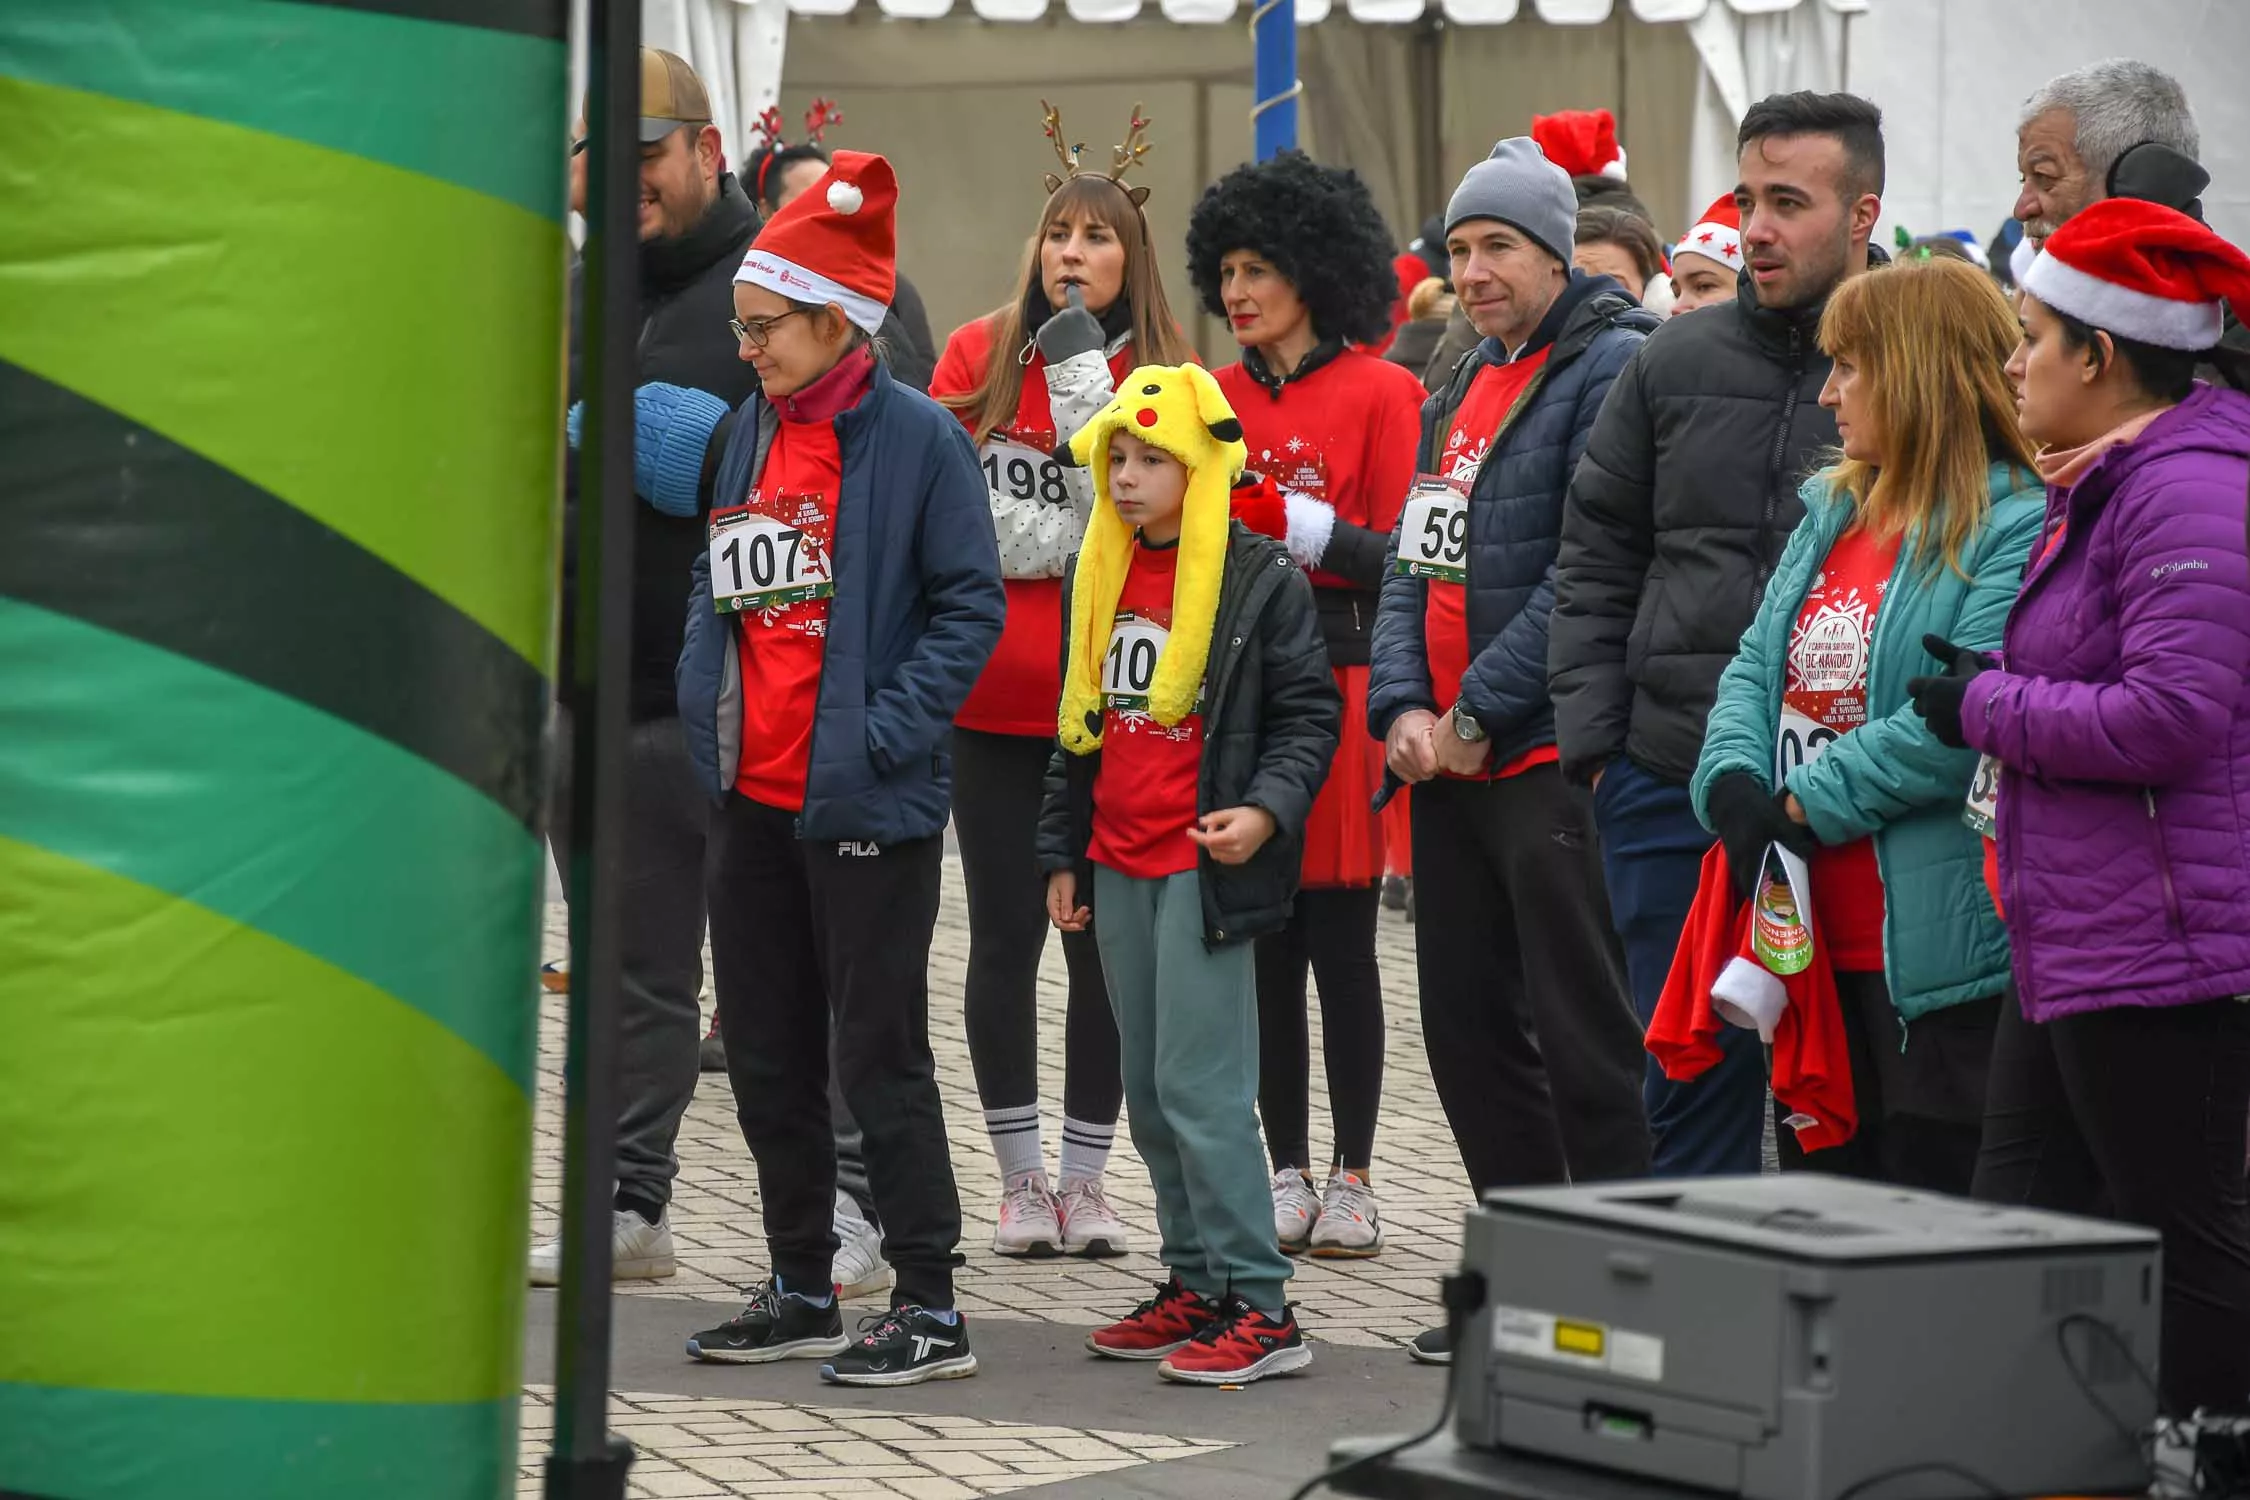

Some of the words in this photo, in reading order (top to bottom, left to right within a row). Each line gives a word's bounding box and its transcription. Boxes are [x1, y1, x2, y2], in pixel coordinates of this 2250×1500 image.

[983, 453, 1068, 504] 198
[722, 530, 804, 590] 107
[1421, 507, 1466, 563] 59
[2161, 560, 2209, 574] Columbia
[838, 841, 880, 857] FILA
